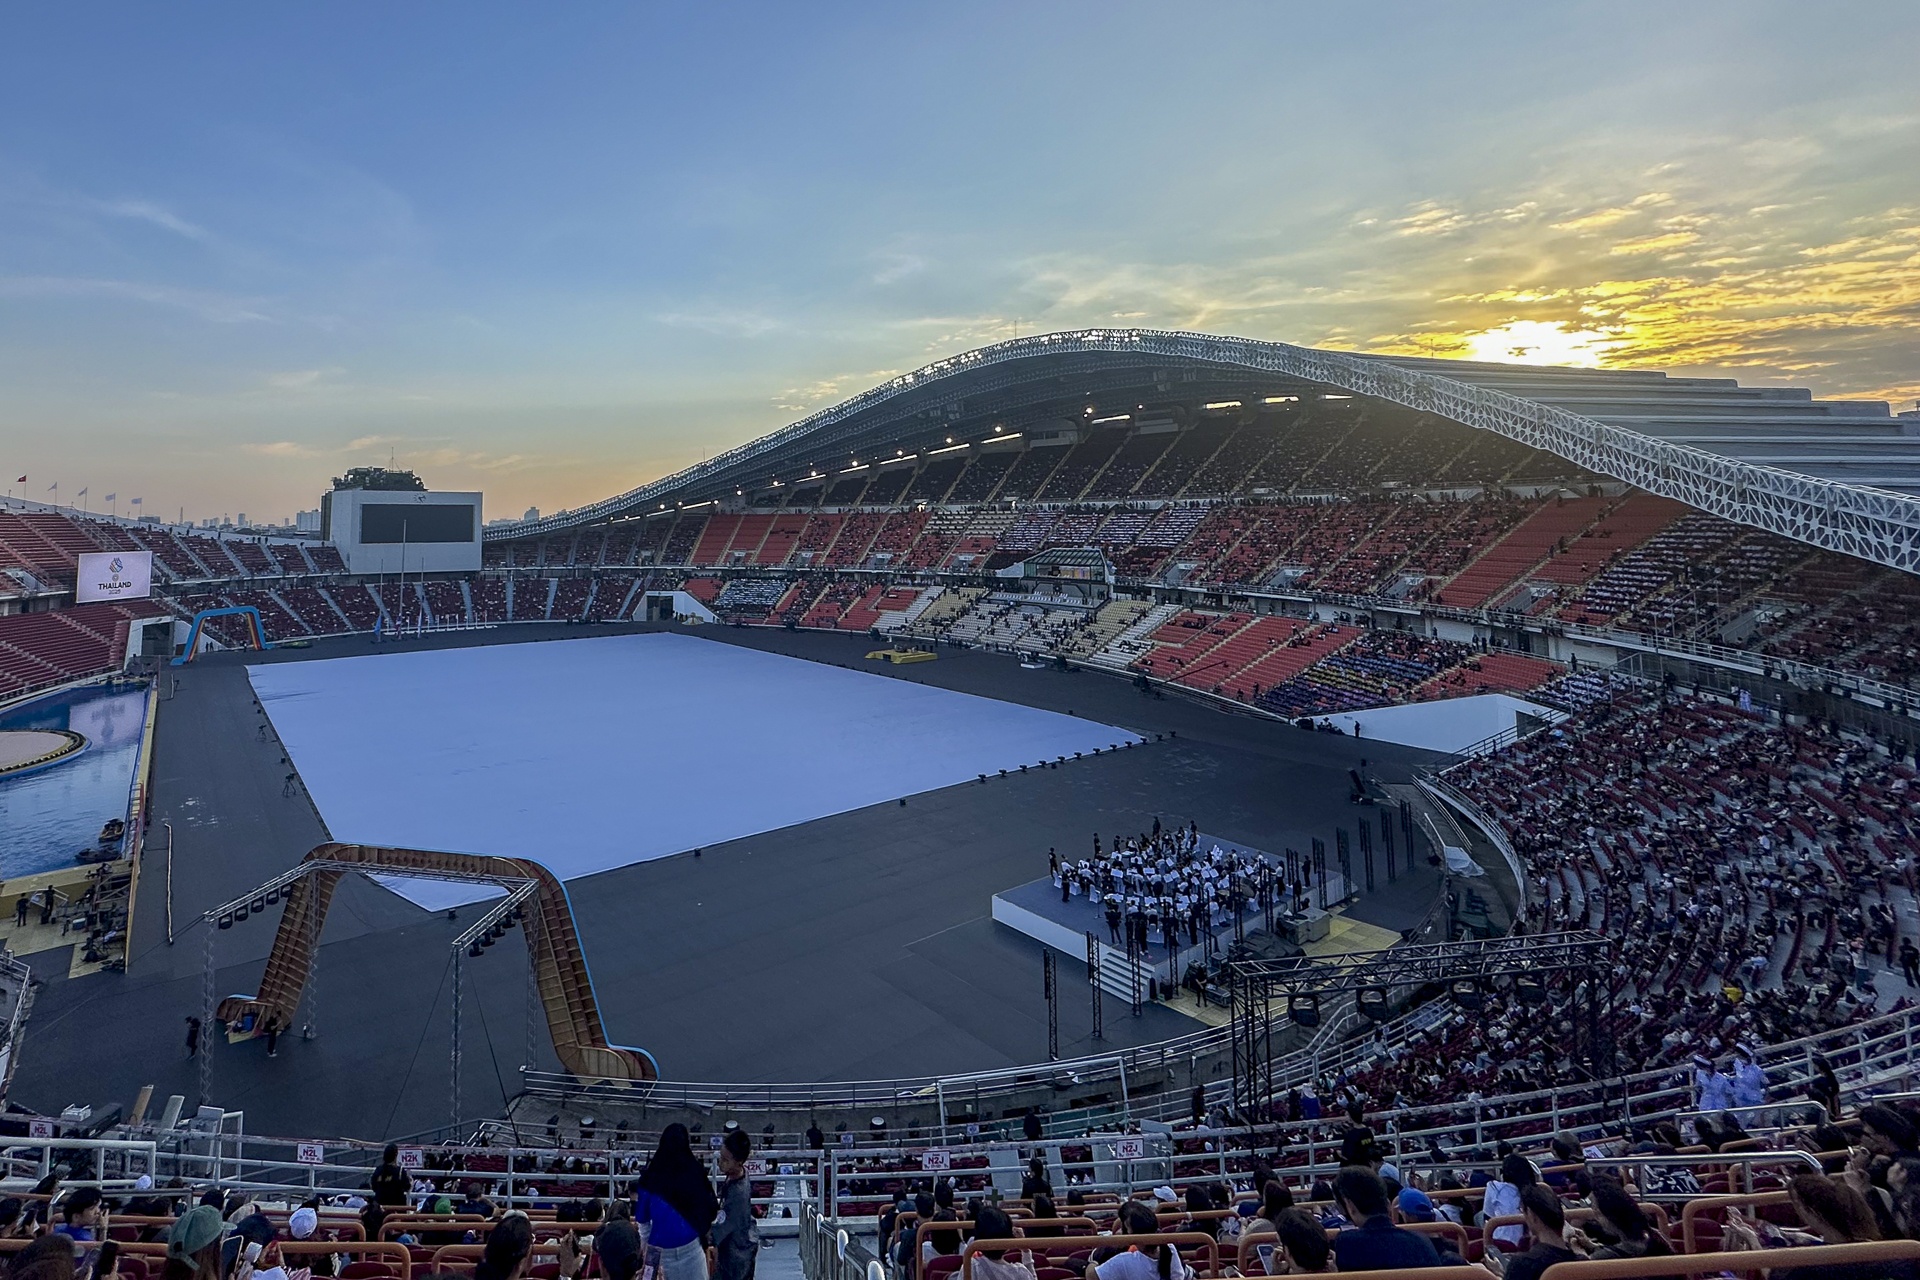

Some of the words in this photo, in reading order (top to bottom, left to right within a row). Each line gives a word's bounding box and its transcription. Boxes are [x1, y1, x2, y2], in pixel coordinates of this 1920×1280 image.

[97, 581, 132, 590] THAILAND
[303, 1149, 318, 1157] N2L
[1122, 1144, 1138, 1153] N2J
[401, 1154, 418, 1163] N2K
[928, 1156, 944, 1165] N2J
